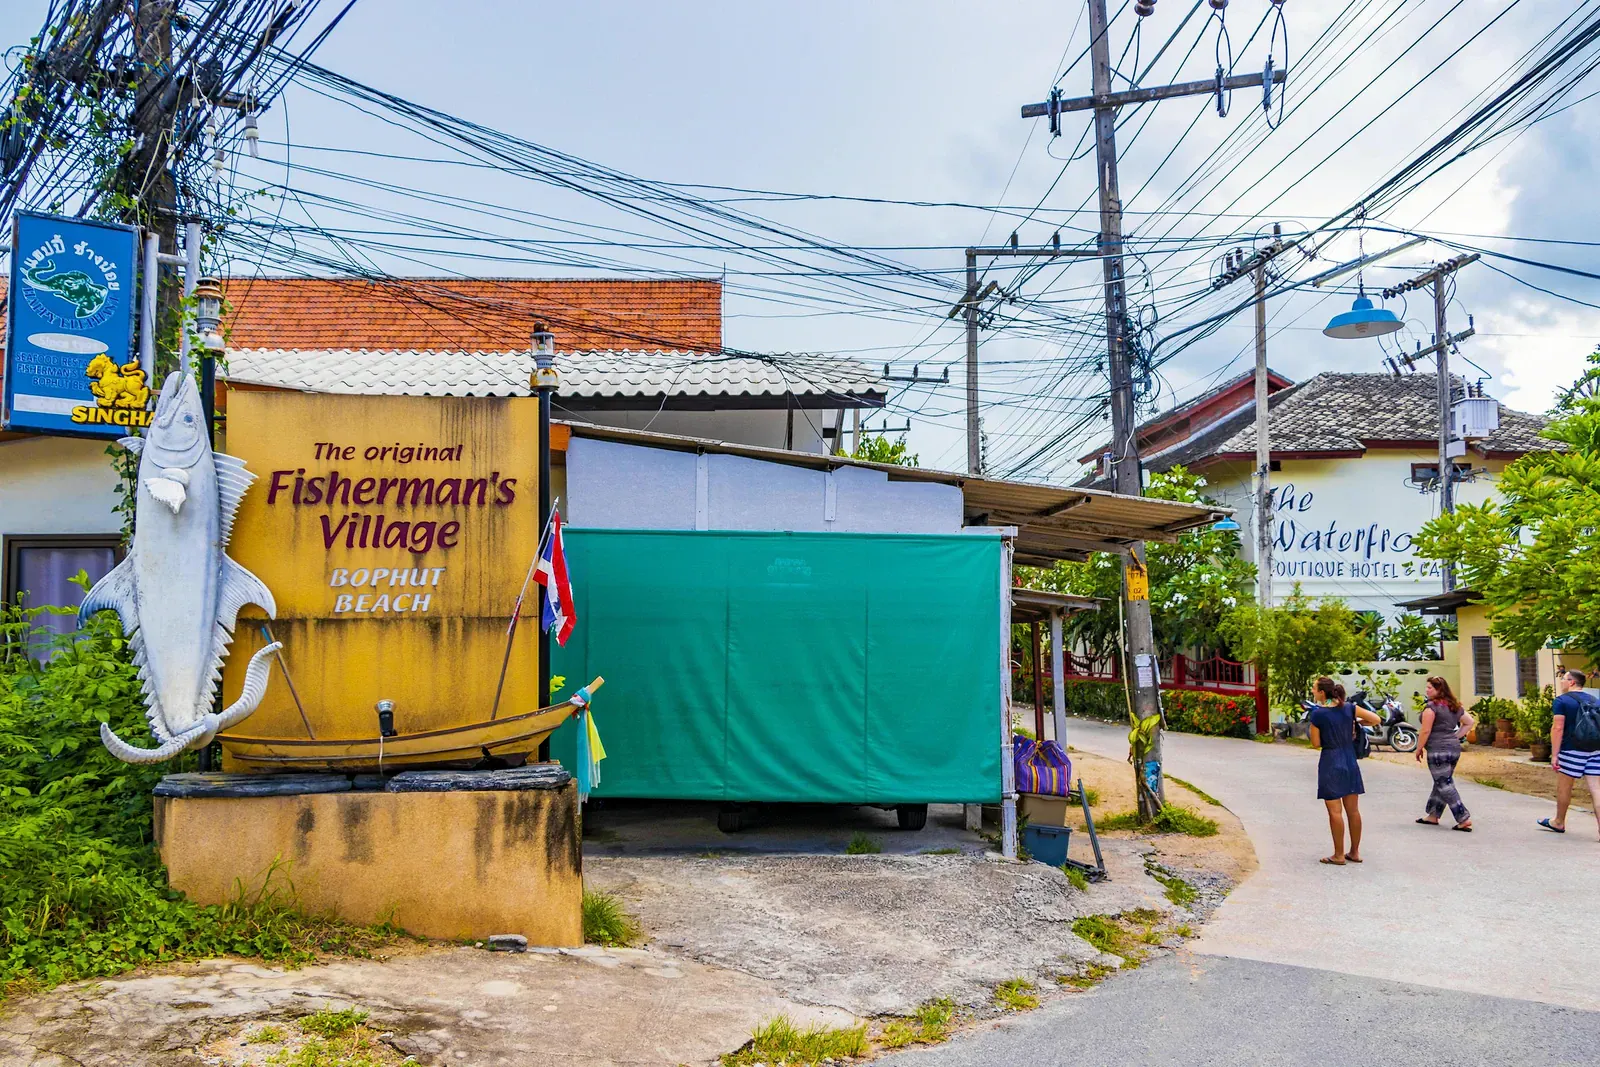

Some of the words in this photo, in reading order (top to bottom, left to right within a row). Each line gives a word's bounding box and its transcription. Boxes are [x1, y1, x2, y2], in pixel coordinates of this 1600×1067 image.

[73, 240, 120, 291] ช้างน้อย
[22, 286, 58, 325] HAPPY
[59, 296, 120, 331] ELEPHANT
[16, 352, 59, 366] SEAFOOD
[61, 357, 89, 369] RESTA
[17, 363, 77, 378] FISHERMAN'S
[32, 376, 71, 389] BOPHUT
[72, 380, 91, 391] BEA
[314, 442, 356, 460] The
[364, 442, 464, 464] original
[266, 468, 518, 506] Fisherman's
[1270, 483, 1314, 512] he
[319, 512, 461, 554] Village
[1273, 520, 1421, 560] Waterfro
[329, 567, 446, 588] BOPHUT
[1273, 560, 1345, 577] OUTIQUE
[1350, 561, 1399, 578] HOTEL
[1420, 562, 1440, 577] CA
[334, 593, 433, 613] BEACH
